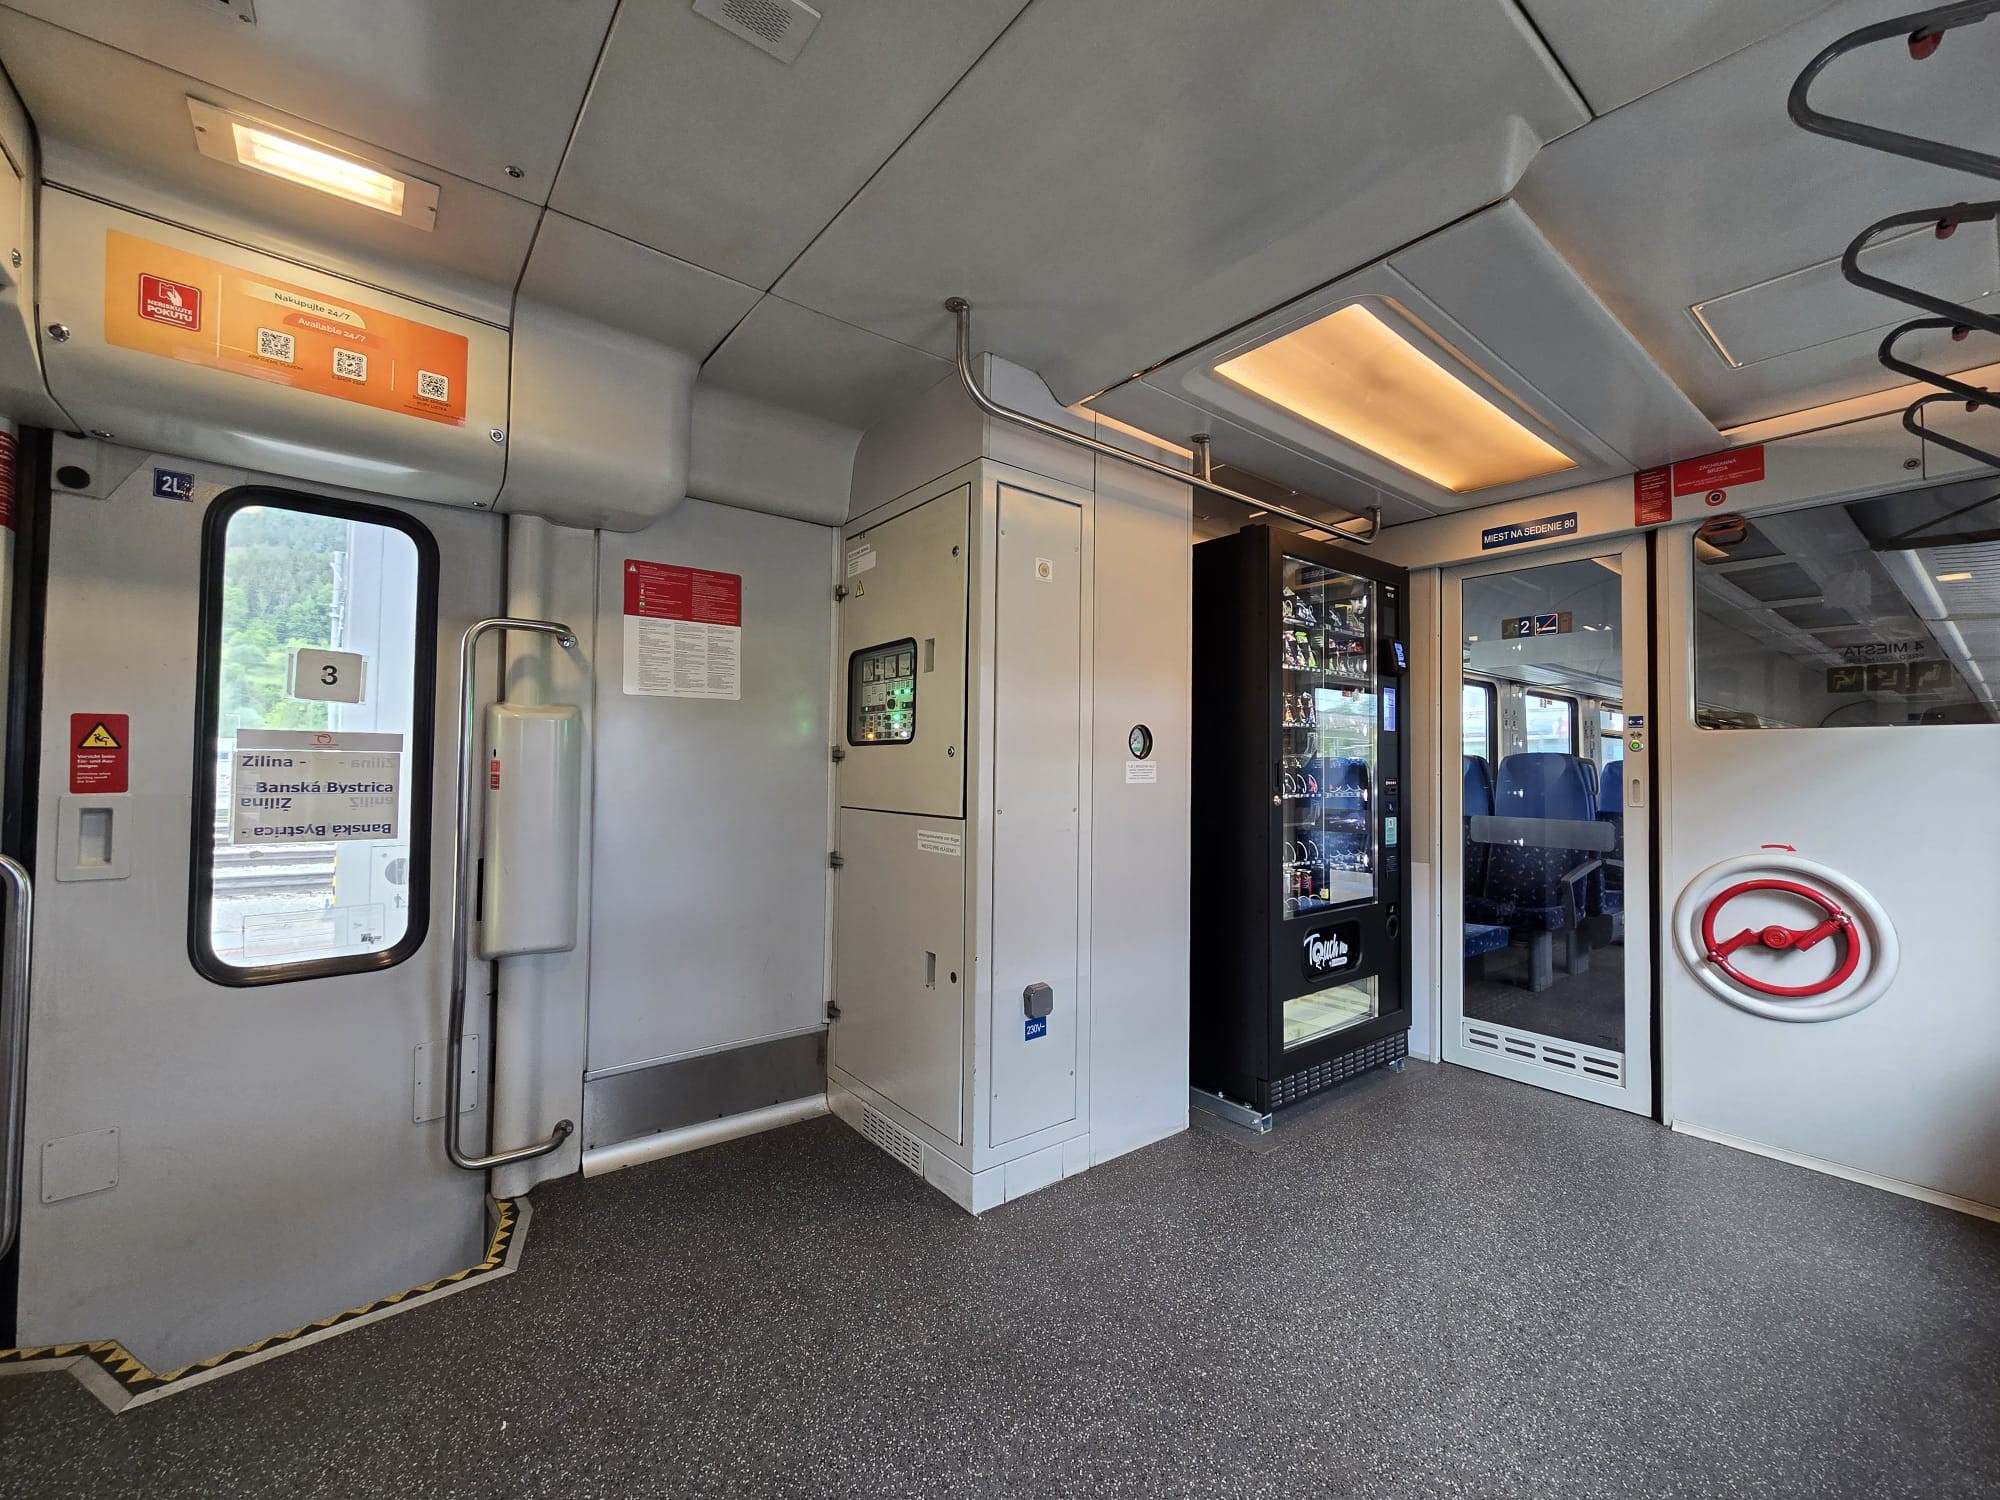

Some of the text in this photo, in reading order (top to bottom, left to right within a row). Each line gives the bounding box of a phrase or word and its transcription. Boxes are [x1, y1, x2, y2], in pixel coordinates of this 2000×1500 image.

[147, 305, 193, 322] POKUTU
[274, 292, 350, 320] Nakupujte 24/7
[298, 318, 366, 343] Available 24/7
[161, 476, 184, 494] 2L
[1484, 519, 1575, 544] MIEST NA SEDENIE 80
[1520, 620, 1530, 634] 2
[321, 665, 338, 685] 3
[242, 753, 294, 768] Žilina
[256, 781, 393, 794] Banská Bystrica
[240, 797, 292, 812] Žilina
[254, 825, 326, 839] Bystrica
[332, 824, 392, 838] Banská
